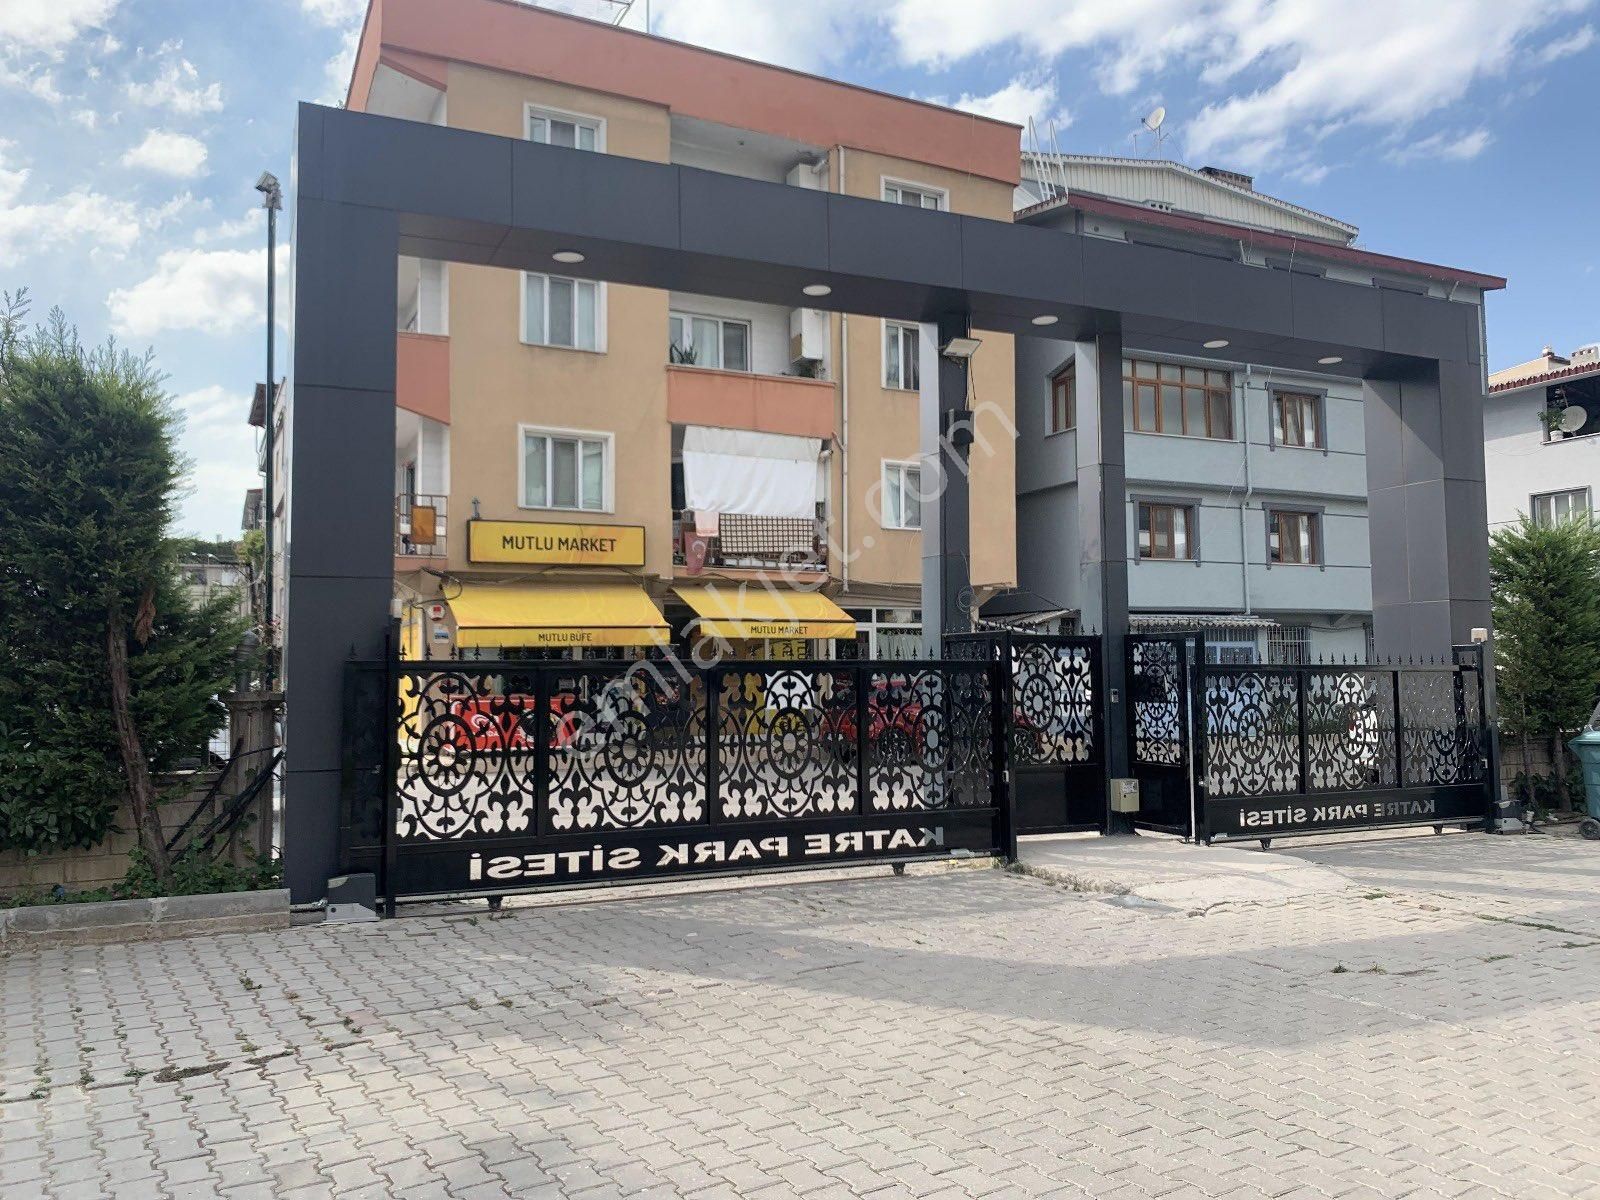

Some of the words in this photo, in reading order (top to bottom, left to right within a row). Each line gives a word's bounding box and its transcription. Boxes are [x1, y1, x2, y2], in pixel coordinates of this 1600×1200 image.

[502, 535, 553, 550] MUTLU
[558, 538, 617, 552] MARKET
[750, 626, 777, 634] MUTLU
[778, 626, 808, 635] MARKET
[538, 633, 569, 642] MUTLU
[570, 631, 592, 642] BÜFE
